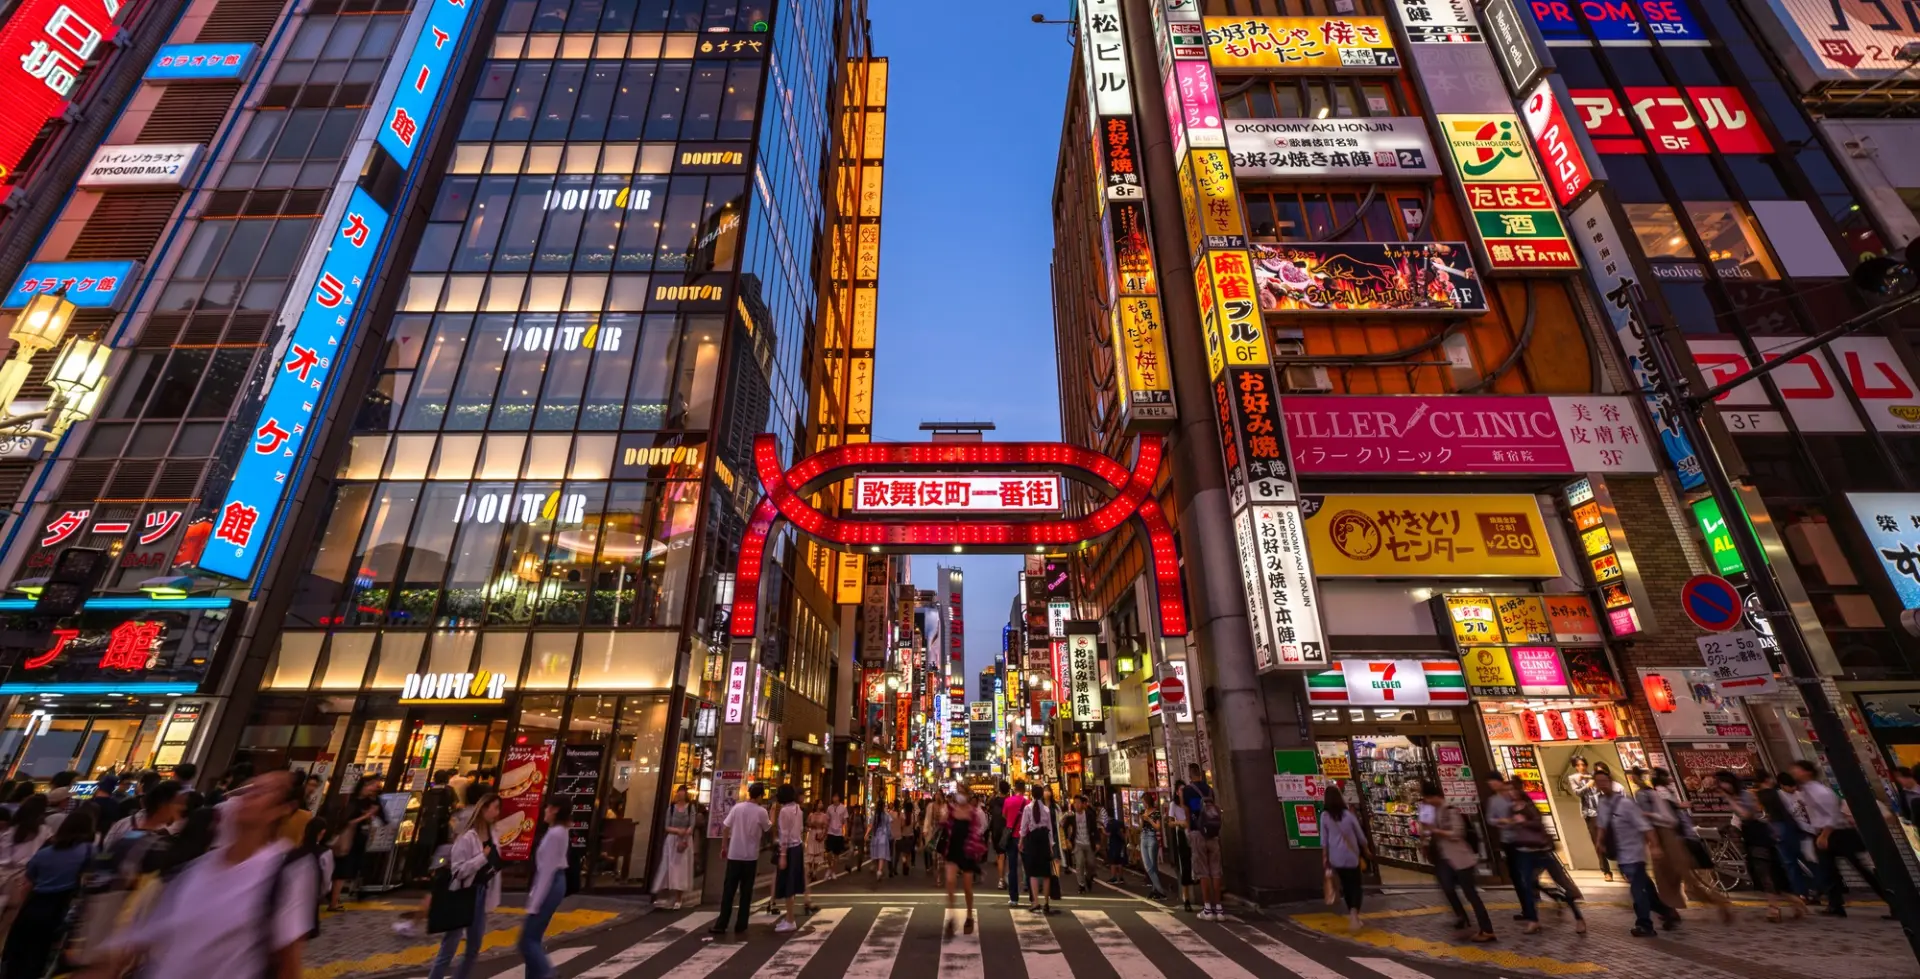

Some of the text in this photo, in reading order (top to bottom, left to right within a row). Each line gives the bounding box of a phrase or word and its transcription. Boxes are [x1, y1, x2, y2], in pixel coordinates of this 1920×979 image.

[1536, 1, 1682, 23] PROMISE
[1171, 24, 1201, 34] たばこ
[1205, 21, 1270, 45] お好み
[1320, 20, 1381, 45] 焼き
[1627, 22, 1689, 34] プロミス
[1092, 0, 1126, 92] 松ビル
[1224, 28, 1309, 58] もんじゃ
[1826, 42, 1851, 57] B1
[158, 54, 241, 67] カラオケ館
[1273, 42, 1325, 63] たこ
[1340, 48, 1373, 59] 本陣
[1376, 51, 1396, 64] 7F
[1195, 65, 1209, 103] フィラー
[1181, 77, 1201, 127] クリニック
[1573, 96, 1748, 130] アイフル
[1235, 123, 1394, 133] OKONOMIYAKI HONJIN
[1108, 119, 1133, 173] お好み焼
[1289, 138, 1358, 147] 歌舞伎町名物
[1660, 135, 1691, 150] 5F
[99, 153, 185, 164] ハイレゾカラオケ
[681, 151, 742, 164] DOUTOR
[1231, 151, 1373, 168] お好み焼き本陣
[1399, 152, 1422, 165] 2F
[1543, 125, 1577, 182] アコム
[91, 165, 145, 176] JOYSOUND
[1198, 156, 1225, 194] もんじゃ
[1208, 152, 1229, 180] お好み
[1110, 173, 1137, 184] 本陣
[1199, 178, 1216, 197] たこ
[1565, 175, 1581, 195] 3F
[543, 187, 652, 210] DOUTOR
[1116, 186, 1135, 196] 8F
[1471, 187, 1547, 207] たばこ
[1207, 199, 1231, 232] 焼き
[1500, 214, 1537, 235] 酒
[1229, 236, 1242, 247] 7F
[1586, 217, 1617, 276] 築地海鮮
[1491, 244, 1571, 262] 銀行ATM
[20, 277, 117, 292] カラオケ館
[655, 285, 722, 300] DOUTOR
[1126, 277, 1147, 291] 4F
[1213, 253, 1260, 342] 麻雀ブル
[1449, 288, 1472, 303] 4F
[1138, 299, 1158, 330] お好み
[1128, 304, 1153, 344] もんじゃ
[502, 324, 622, 351] DOUTOR
[1128, 328, 1143, 348] たこ
[1236, 345, 1258, 362] 6F
[1135, 351, 1158, 387] 焼き
[1692, 351, 1914, 402] アコム
[216, 212, 371, 548] カラオケ館
[1154, 391, 1167, 402] 7F
[1239, 371, 1280, 458] お好み焼
[1570, 402, 1622, 422] 美容
[1730, 413, 1761, 429] 3F
[1430, 411, 1557, 439] CLINIC
[1570, 425, 1640, 445] 皮膚科
[624, 446, 698, 466] DOUTOR
[1356, 446, 1453, 464] クリニック
[1492, 450, 1535, 462] 新宿院
[1600, 449, 1624, 466] 3F
[1250, 460, 1287, 477] 本陣
[862, 481, 1053, 506] 歌舞伎町一番街
[1258, 481, 1285, 497] 8F
[454, 490, 587, 524] DOUTOR
[1301, 499, 1319, 512] 2F
[41, 509, 182, 548] ダーツ
[1377, 509, 1460, 536] やきとり
[1386, 536, 1475, 563] センター
[1486, 534, 1534, 550] ¥280
[121, 552, 165, 568] BAR
[1286, 511, 1311, 607] OKONOMIYAKI HONJIN
[1260, 521, 1296, 645] お好み焼き本陣
[1499, 598, 1526, 613] お好み
[1503, 604, 1537, 624] もんじゃ
[1551, 604, 1590, 618] お好み焼
[1463, 621, 1488, 633] ブル
[1504, 622, 1523, 635] たこ
[1523, 618, 1548, 633] 焼き
[1303, 644, 1321, 659] 2F
[1517, 651, 1550, 659] FILLER
[1520, 661, 1553, 669] CLINIC
[1713, 665, 1740, 677] を除く
[402, 669, 506, 700] DOUTOR
[730, 665, 744, 719] 劇場通り
[1371, 680, 1402, 689] ELEVEN
[1324, 757, 1348, 765] ATM
[1441, 751, 1460, 762] SIM
